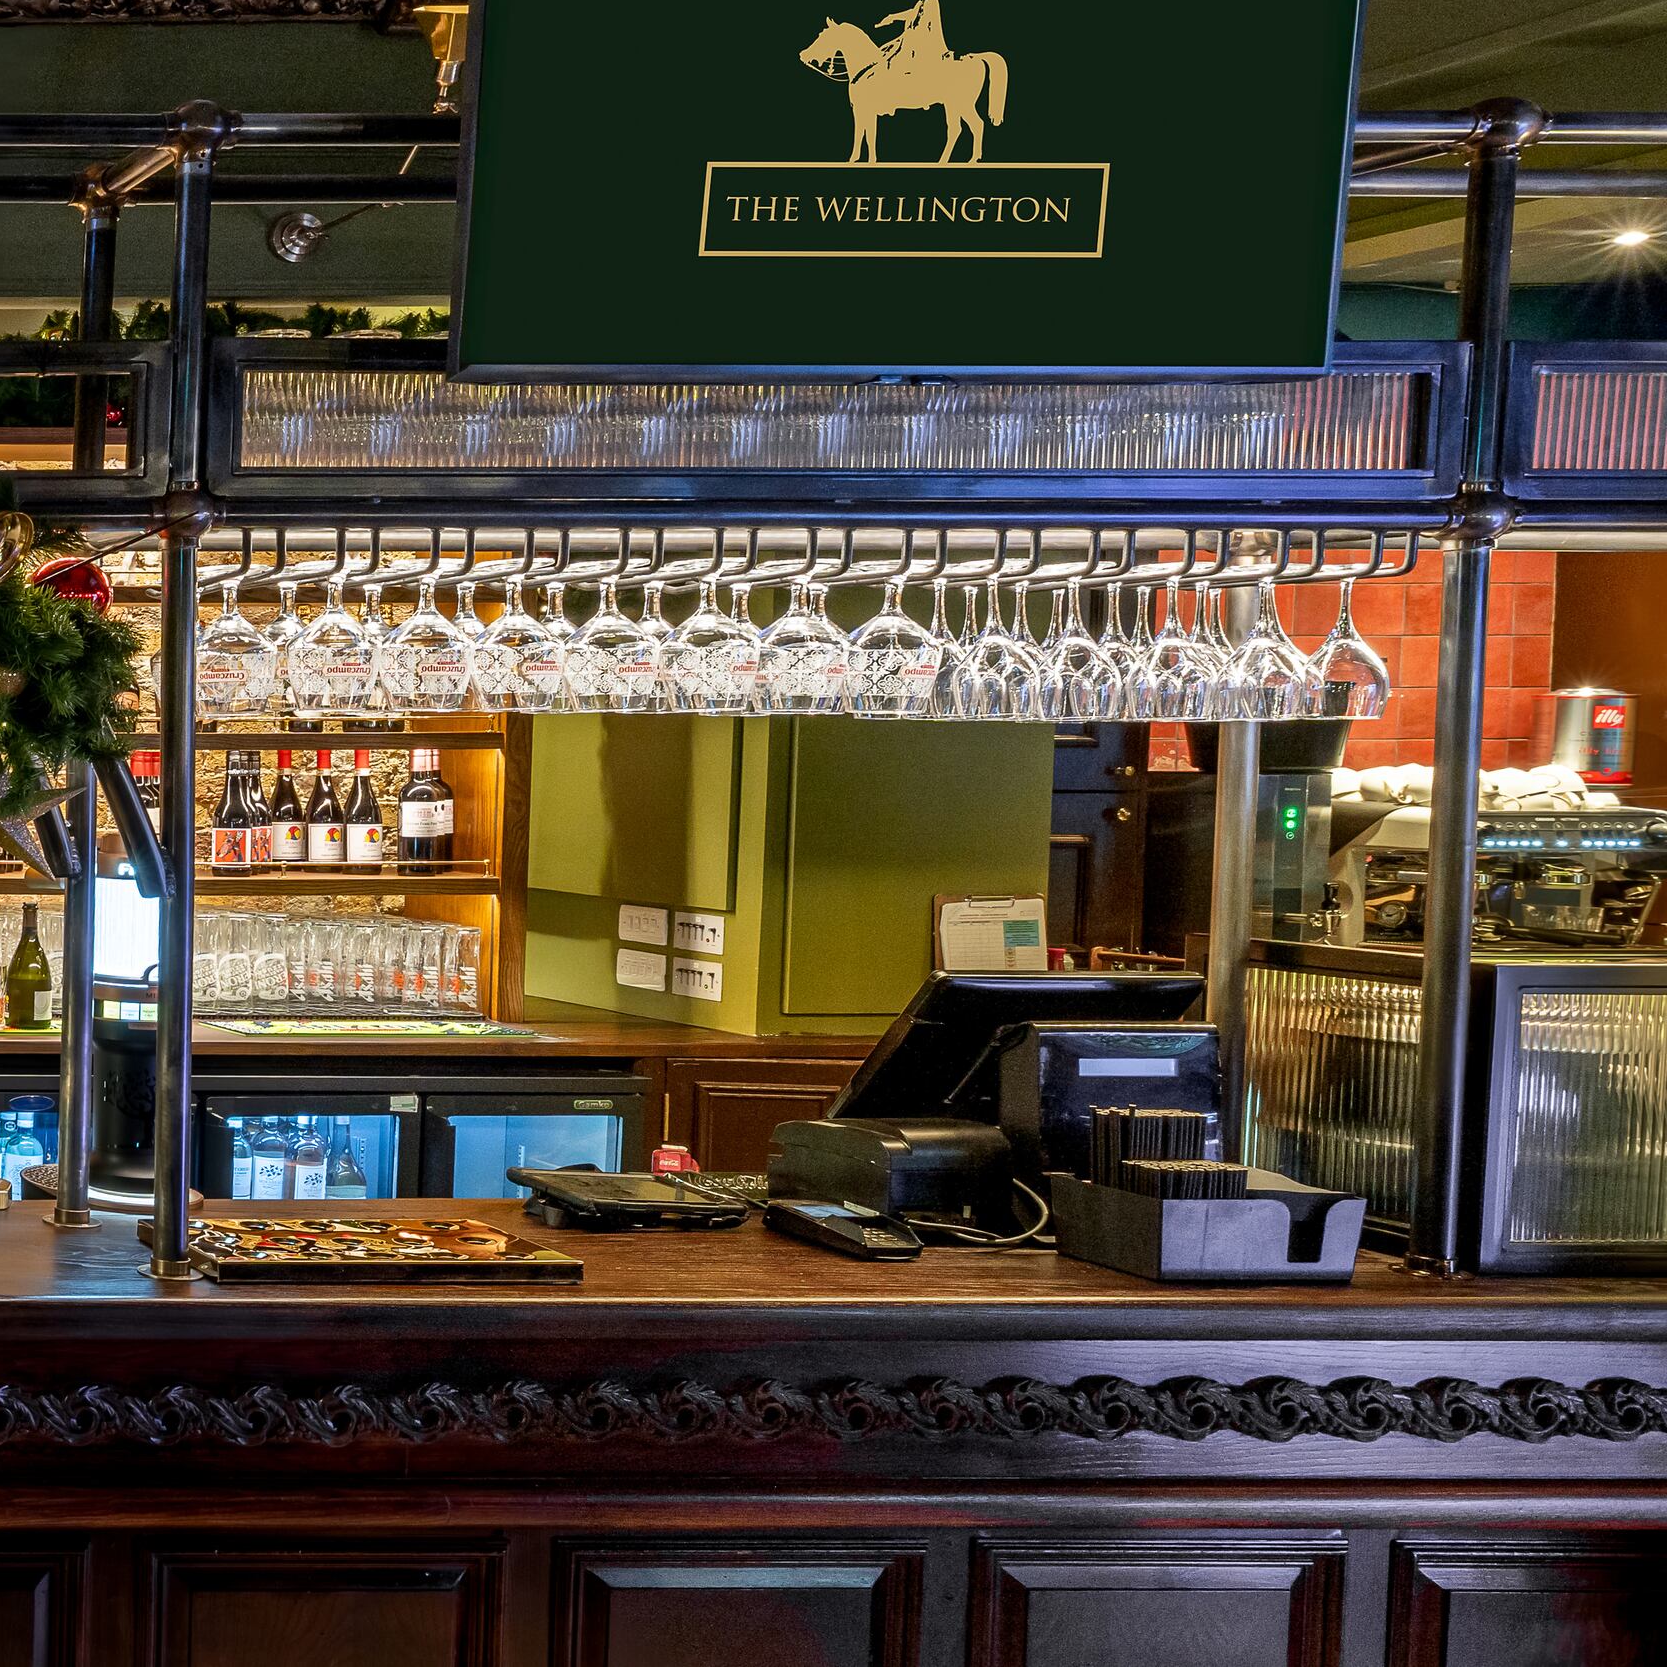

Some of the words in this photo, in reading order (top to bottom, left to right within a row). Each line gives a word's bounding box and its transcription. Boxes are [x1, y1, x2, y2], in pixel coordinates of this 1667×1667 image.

[726, 195, 800, 222] THE
[815, 195, 1071, 223] WELLINGTON
[326, 666, 371, 675] Cruzcampo
[421, 665, 466, 675] Cruzcampo
[199, 672, 245, 681] Cruzcampo
[1595, 709, 1625, 726] illy
[578, 1100, 610, 1109] Gamko
